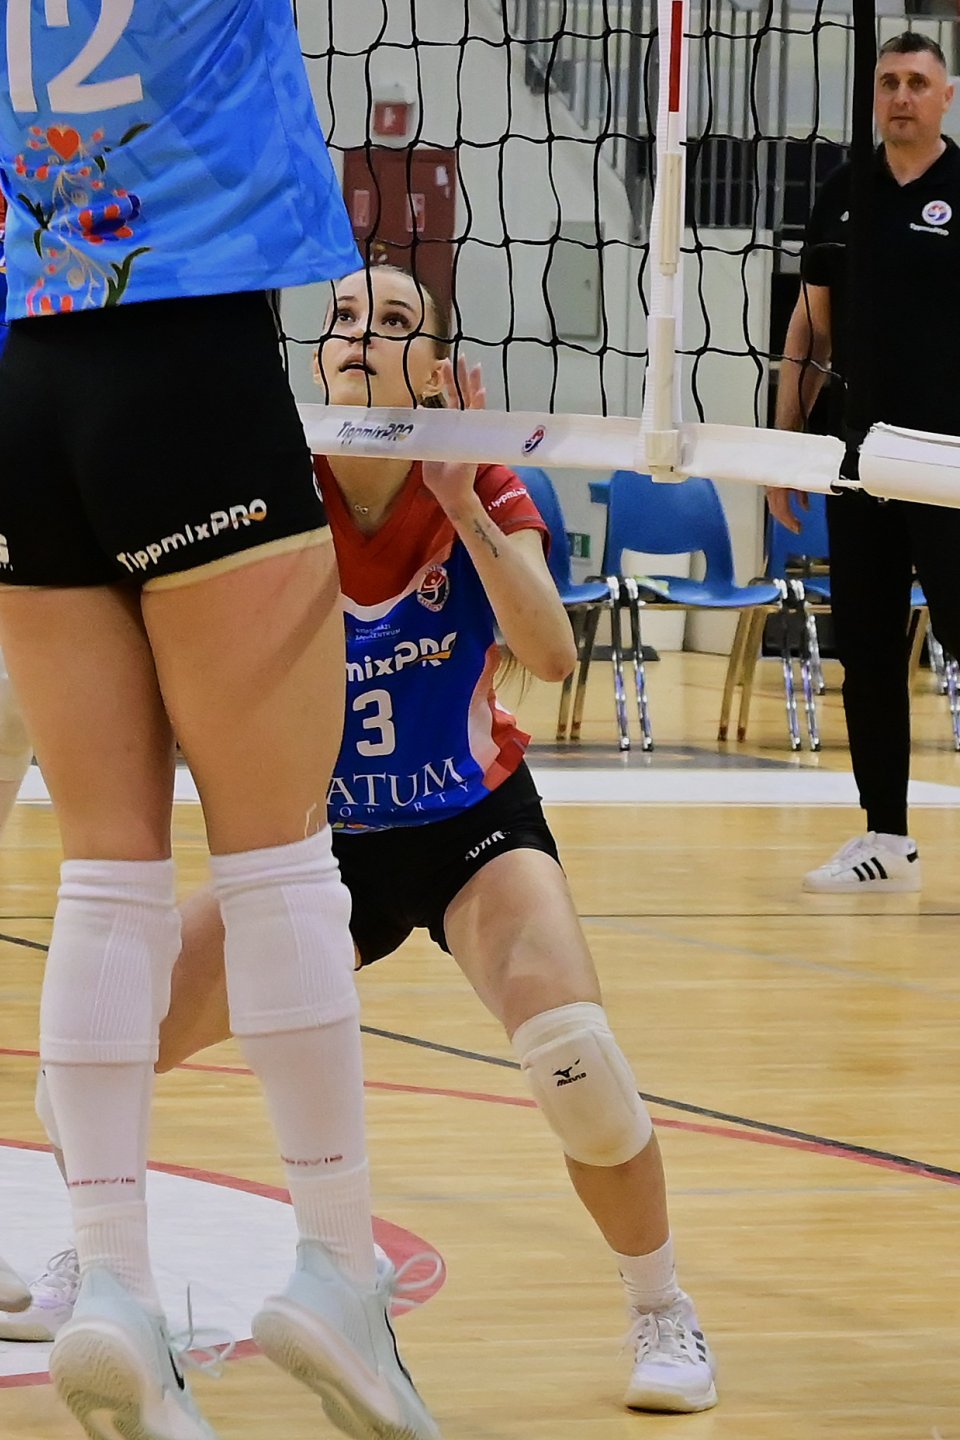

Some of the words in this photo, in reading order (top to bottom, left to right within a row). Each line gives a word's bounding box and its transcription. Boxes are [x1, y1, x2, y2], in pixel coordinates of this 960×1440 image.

[117, 499, 267, 573] TippmixPRO
[353, 689, 396, 757] 3
[326, 757, 466, 807] ATUM
